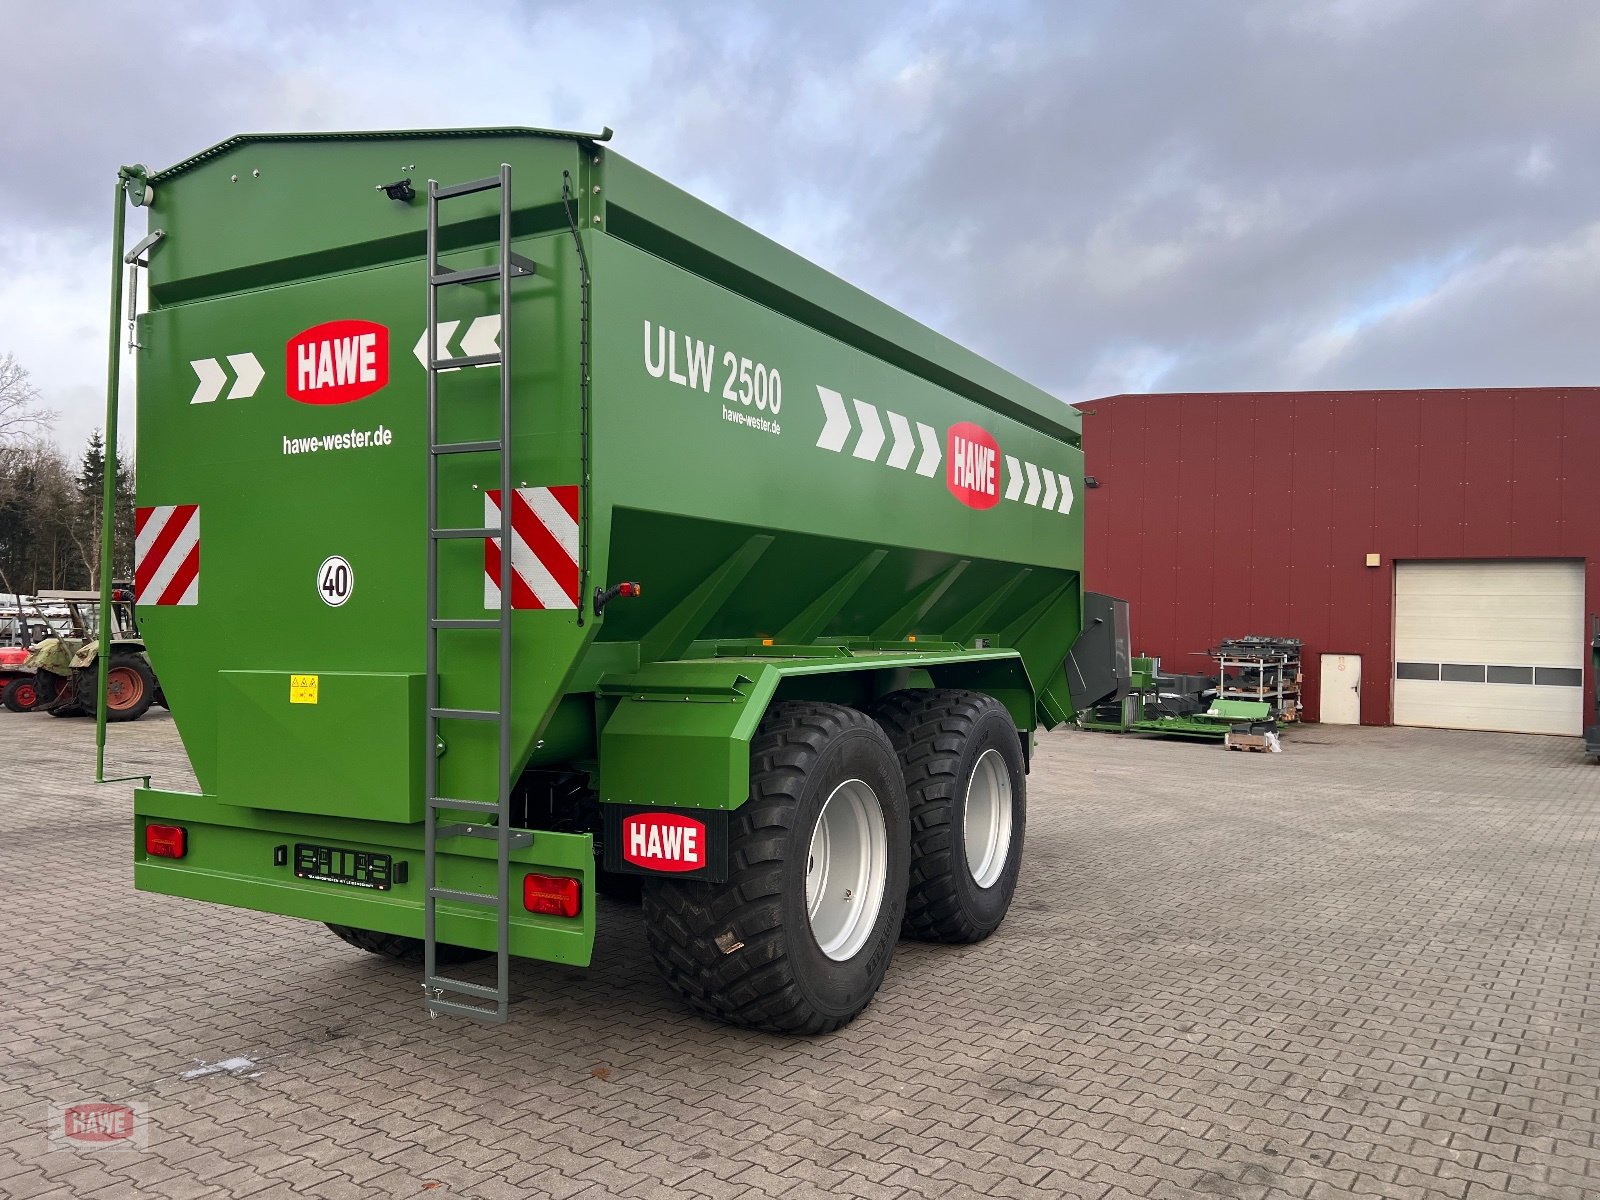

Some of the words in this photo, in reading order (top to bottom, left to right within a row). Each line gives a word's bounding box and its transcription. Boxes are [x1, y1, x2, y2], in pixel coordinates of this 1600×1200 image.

[297, 332, 377, 392] HAWE
[644, 319, 715, 393] ULW
[722, 351, 782, 415] 2500
[283, 424, 393, 455] hawe-wester.de
[722, 404, 781, 435] hawe-wester.de
[954, 435, 995, 496] HAWE
[322, 565, 348, 597] 40
[630, 822, 698, 862] HAWE
